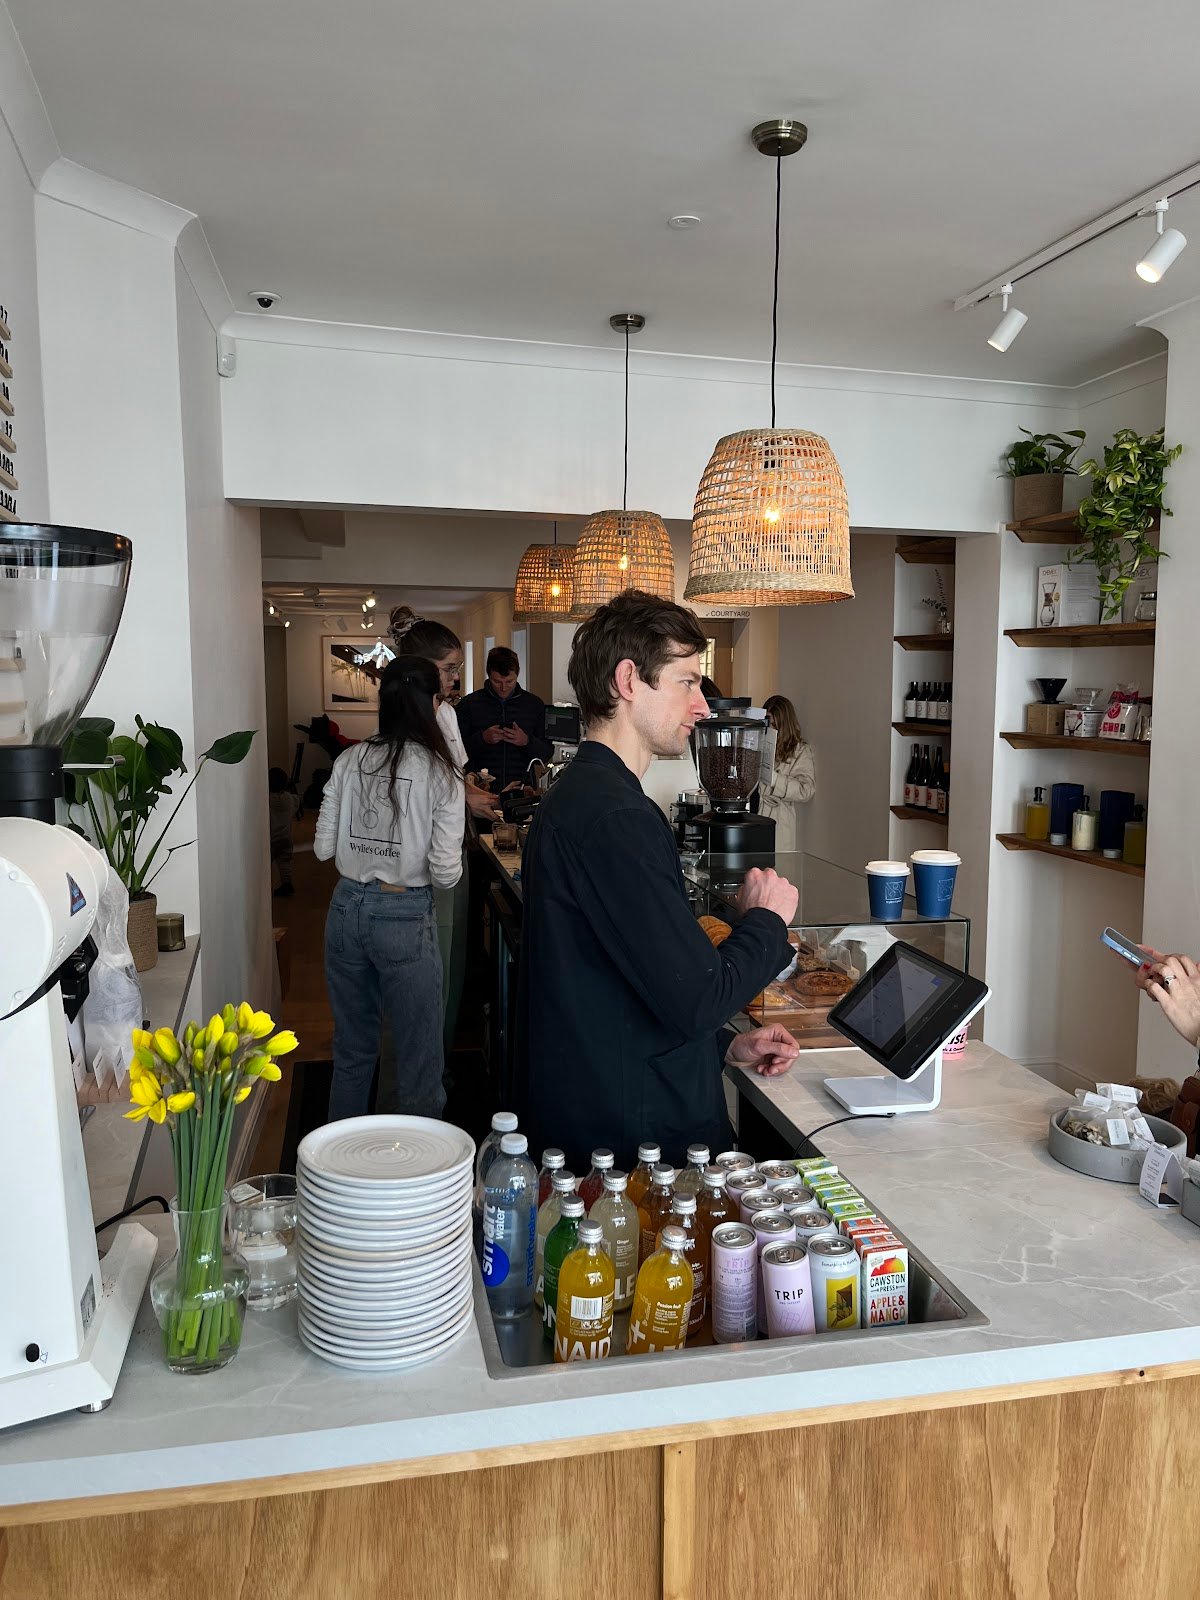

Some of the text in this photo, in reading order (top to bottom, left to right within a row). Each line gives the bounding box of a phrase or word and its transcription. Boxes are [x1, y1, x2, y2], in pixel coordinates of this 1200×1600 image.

[710, 610, 750, 618] COURTYARD
[349, 842, 401, 858] Wylie's Coffee
[495, 1207, 506, 1240] water
[482, 1200, 496, 1276] smart
[526, 1204, 537, 1287] smartwater
[870, 1273, 906, 1288] CAWSTON
[774, 1288, 804, 1301] TRIP
[880, 1285, 896, 1293] PRESS
[871, 1295, 905, 1310] APPLE &
[870, 1307, 906, 1324] MANGO
